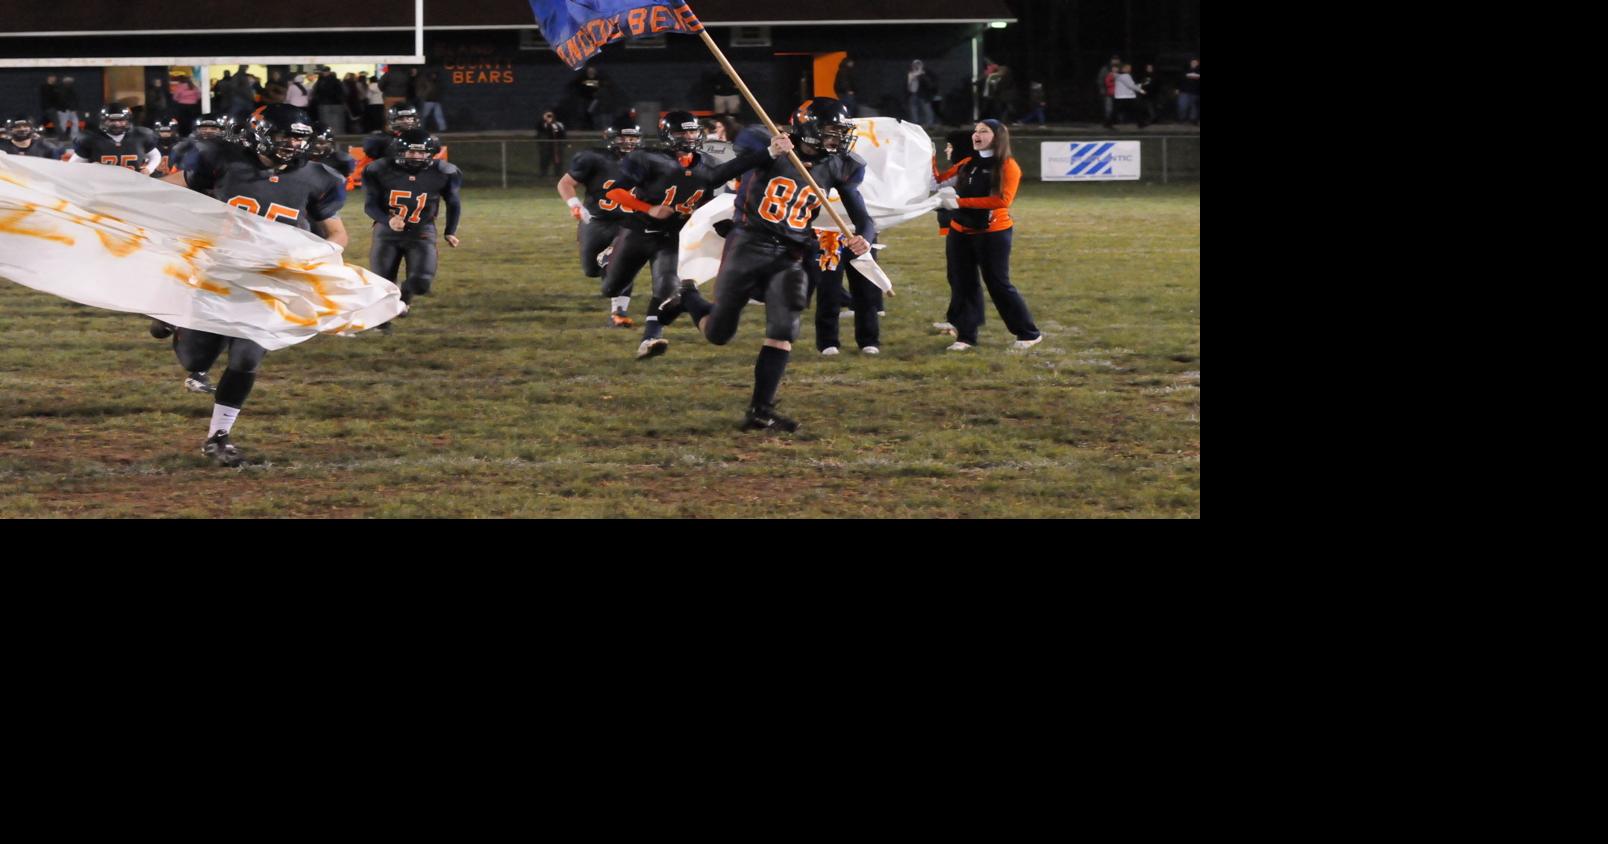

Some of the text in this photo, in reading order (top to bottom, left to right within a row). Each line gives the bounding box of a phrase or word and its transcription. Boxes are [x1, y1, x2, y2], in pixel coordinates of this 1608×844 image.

[452, 70, 514, 84] BEARS
[388, 189, 428, 223] 51
[660, 185, 705, 215] 14
[758, 175, 827, 230] 80
